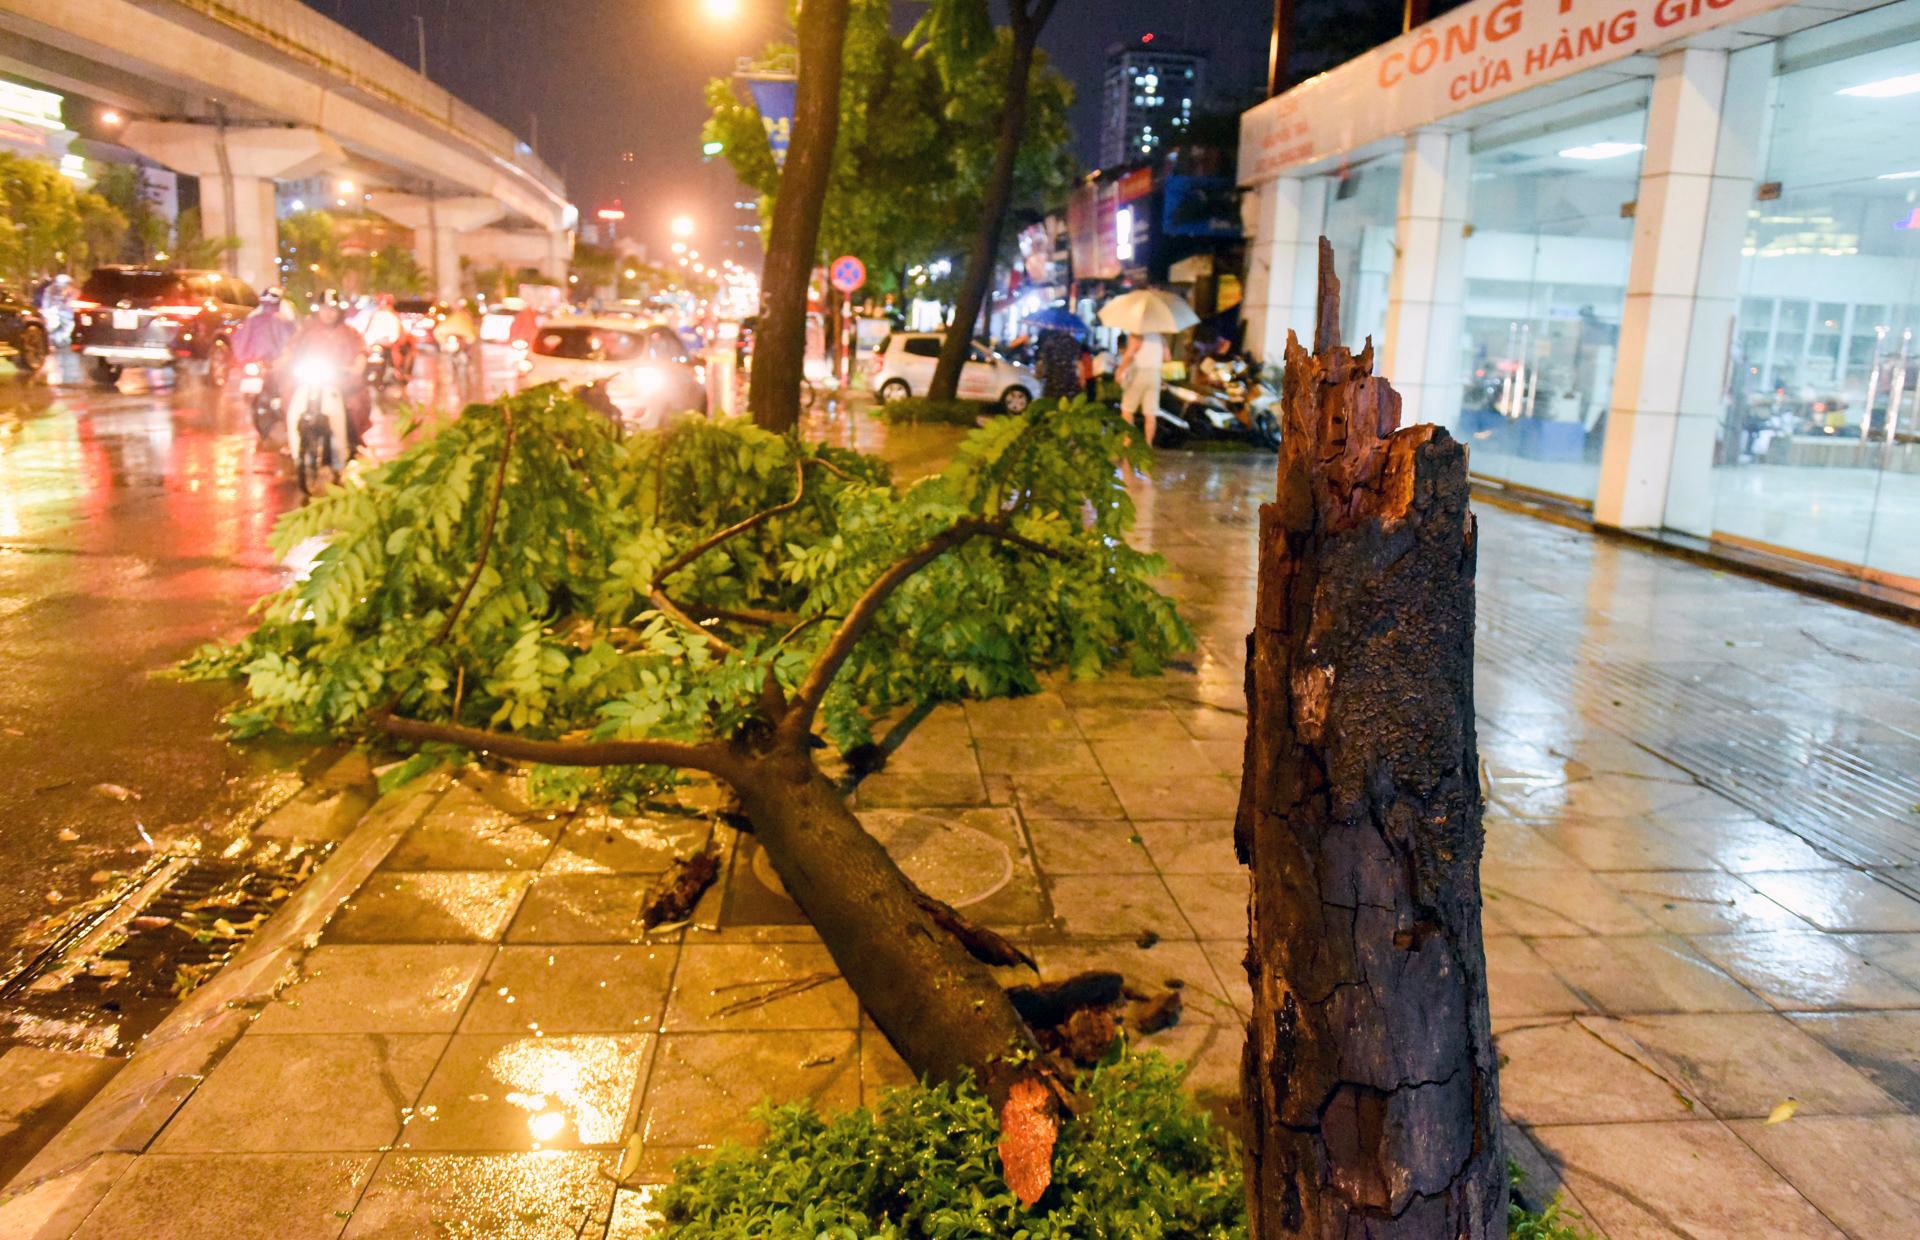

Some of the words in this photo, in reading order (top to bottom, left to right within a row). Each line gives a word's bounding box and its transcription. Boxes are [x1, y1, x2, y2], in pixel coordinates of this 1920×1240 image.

[1378, 0, 1523, 89] CÔNG
[1449, 56, 1512, 101] CỬA
[1524, 9, 1637, 76] HÀNG
